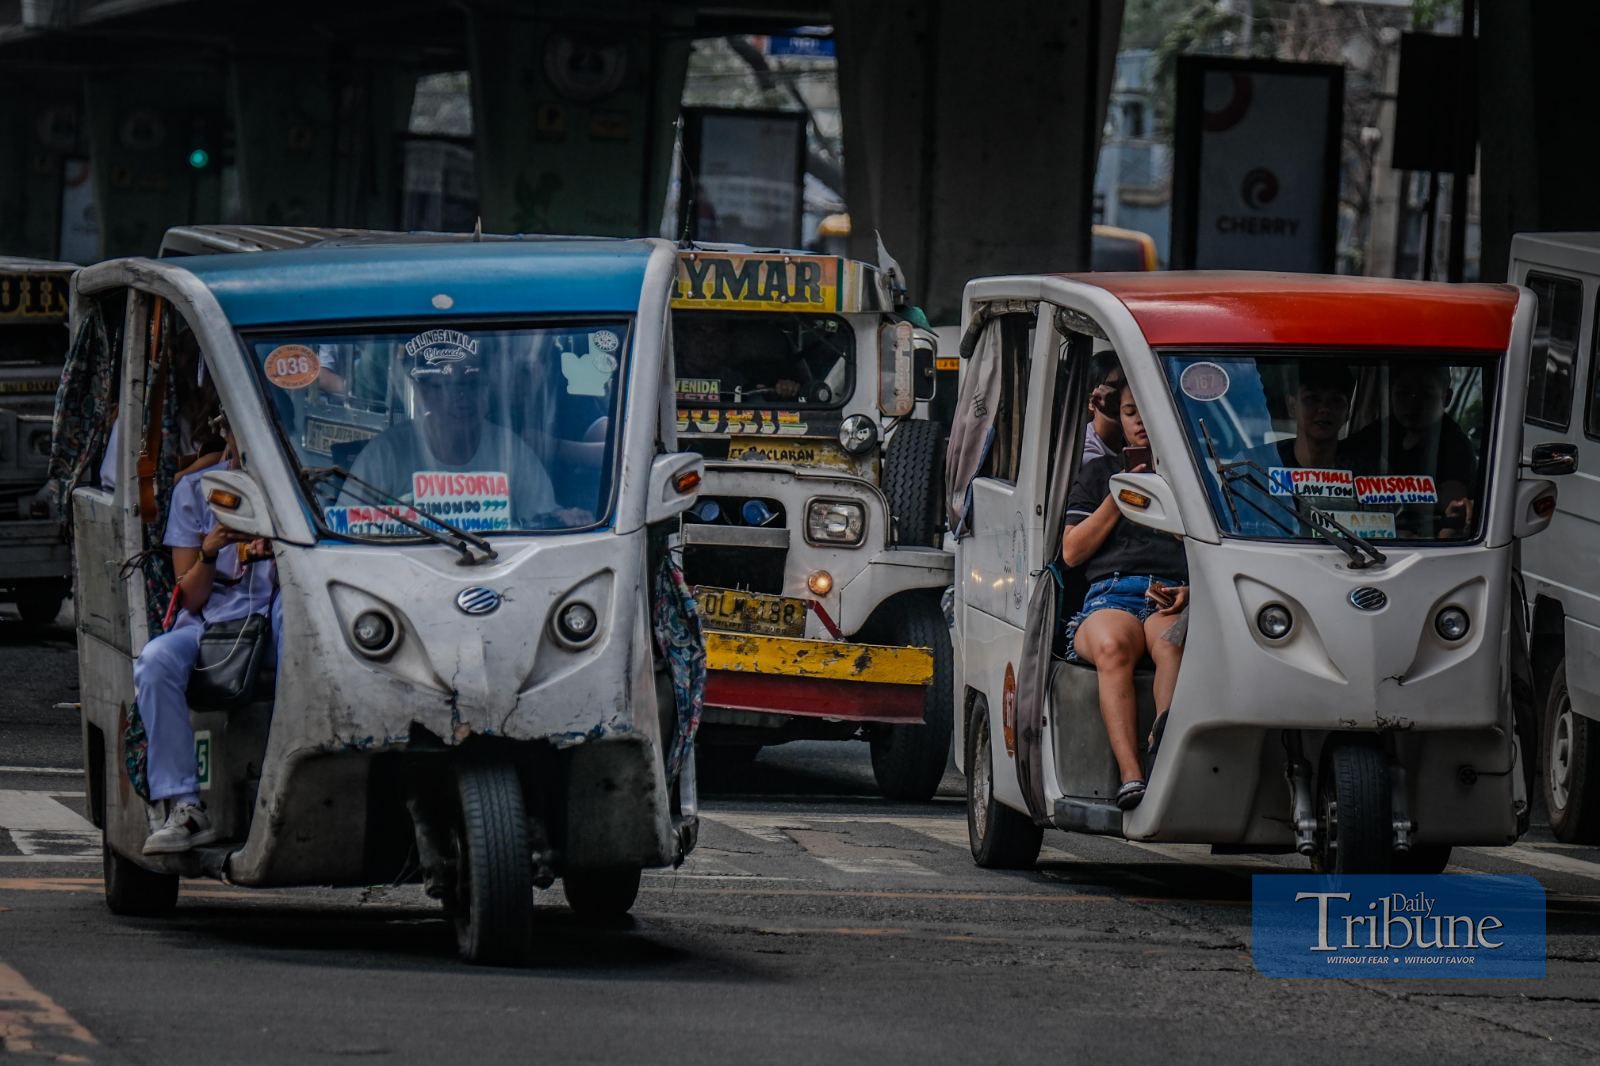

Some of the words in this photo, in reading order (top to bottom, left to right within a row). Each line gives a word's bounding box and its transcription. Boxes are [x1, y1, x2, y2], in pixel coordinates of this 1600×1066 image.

[1216, 214, 1301, 235] CHERRY
[277, 356, 308, 375] 036
[415, 474, 509, 498] DIVISORIA
[1269, 469, 1293, 495] SM
[1355, 476, 1434, 496] DIVISORIA
[1361, 494, 1396, 504] JUAN
[1402, 494, 1436, 503] LUNA
